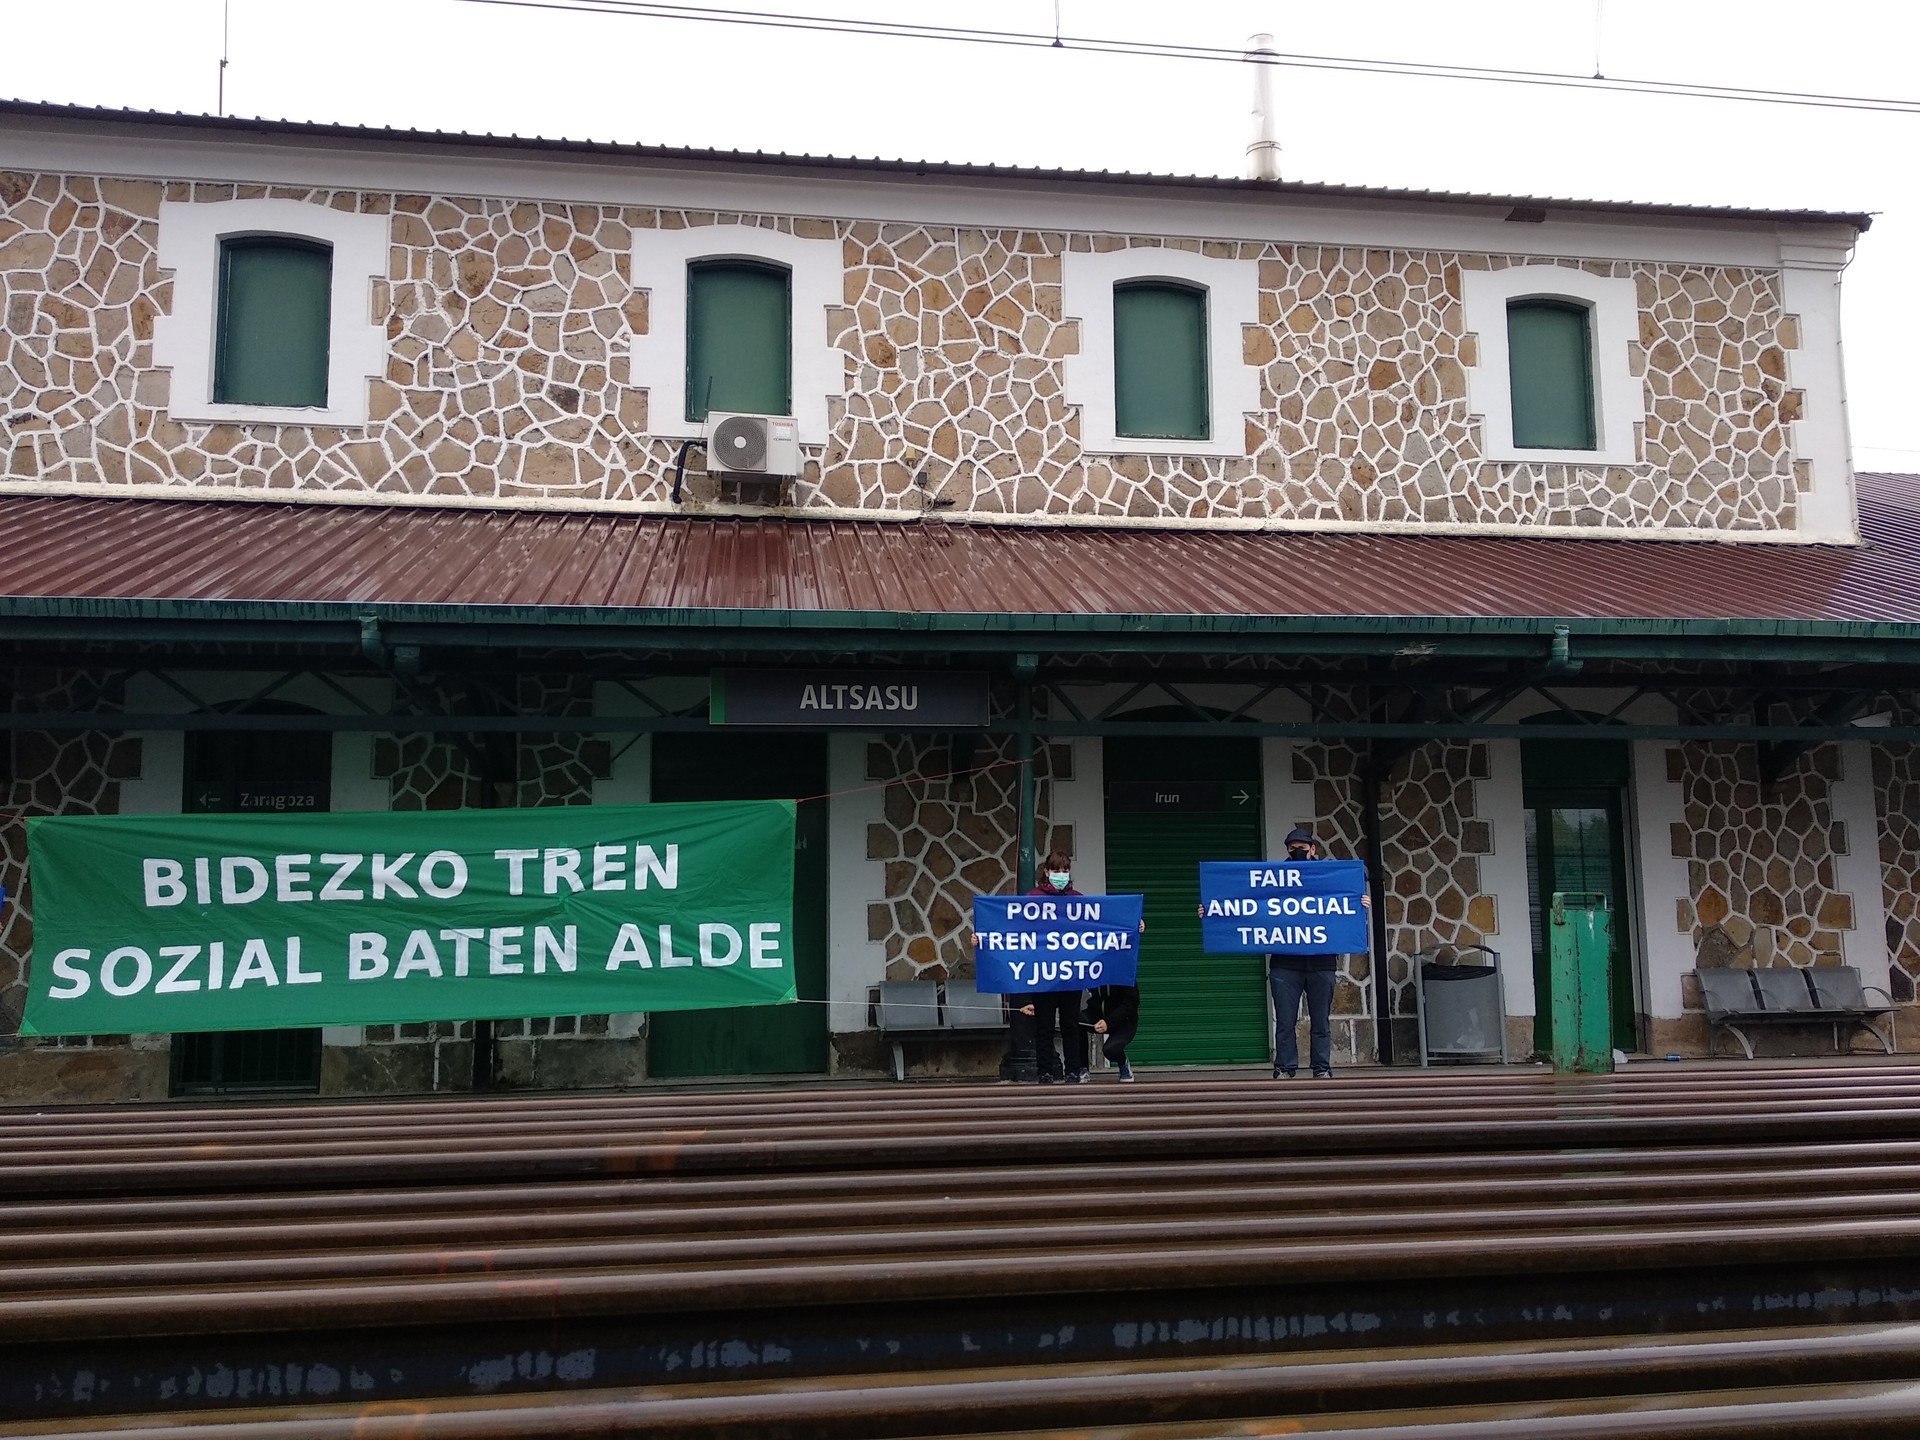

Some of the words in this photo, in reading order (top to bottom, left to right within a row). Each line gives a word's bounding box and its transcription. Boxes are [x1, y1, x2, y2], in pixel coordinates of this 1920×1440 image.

[799, 685, 918, 711] ALTSASU
[240, 793, 315, 810] Zaragoza
[1155, 792, 1180, 803] Irun
[143, 850, 468, 907] BIDEZKO
[494, 841, 679, 896] TREN
[1249, 869, 1303, 888] FAIR
[1007, 902, 1058, 920] POR
[1066, 902, 1101, 921] UN
[1207, 898, 1258, 917] AND
[1267, 896, 1356, 916] SOCIAL
[976, 931, 1037, 951] TREN
[1046, 931, 1132, 951] SOCIAL
[1236, 925, 1328, 945] TRAINS
[48, 936, 323, 1000] SOZIAL
[348, 924, 578, 980] BATEN
[605, 922, 783, 971] ALDE
[1008, 961, 1026, 980] Y
[1026, 960, 1103, 986] JUSTO
